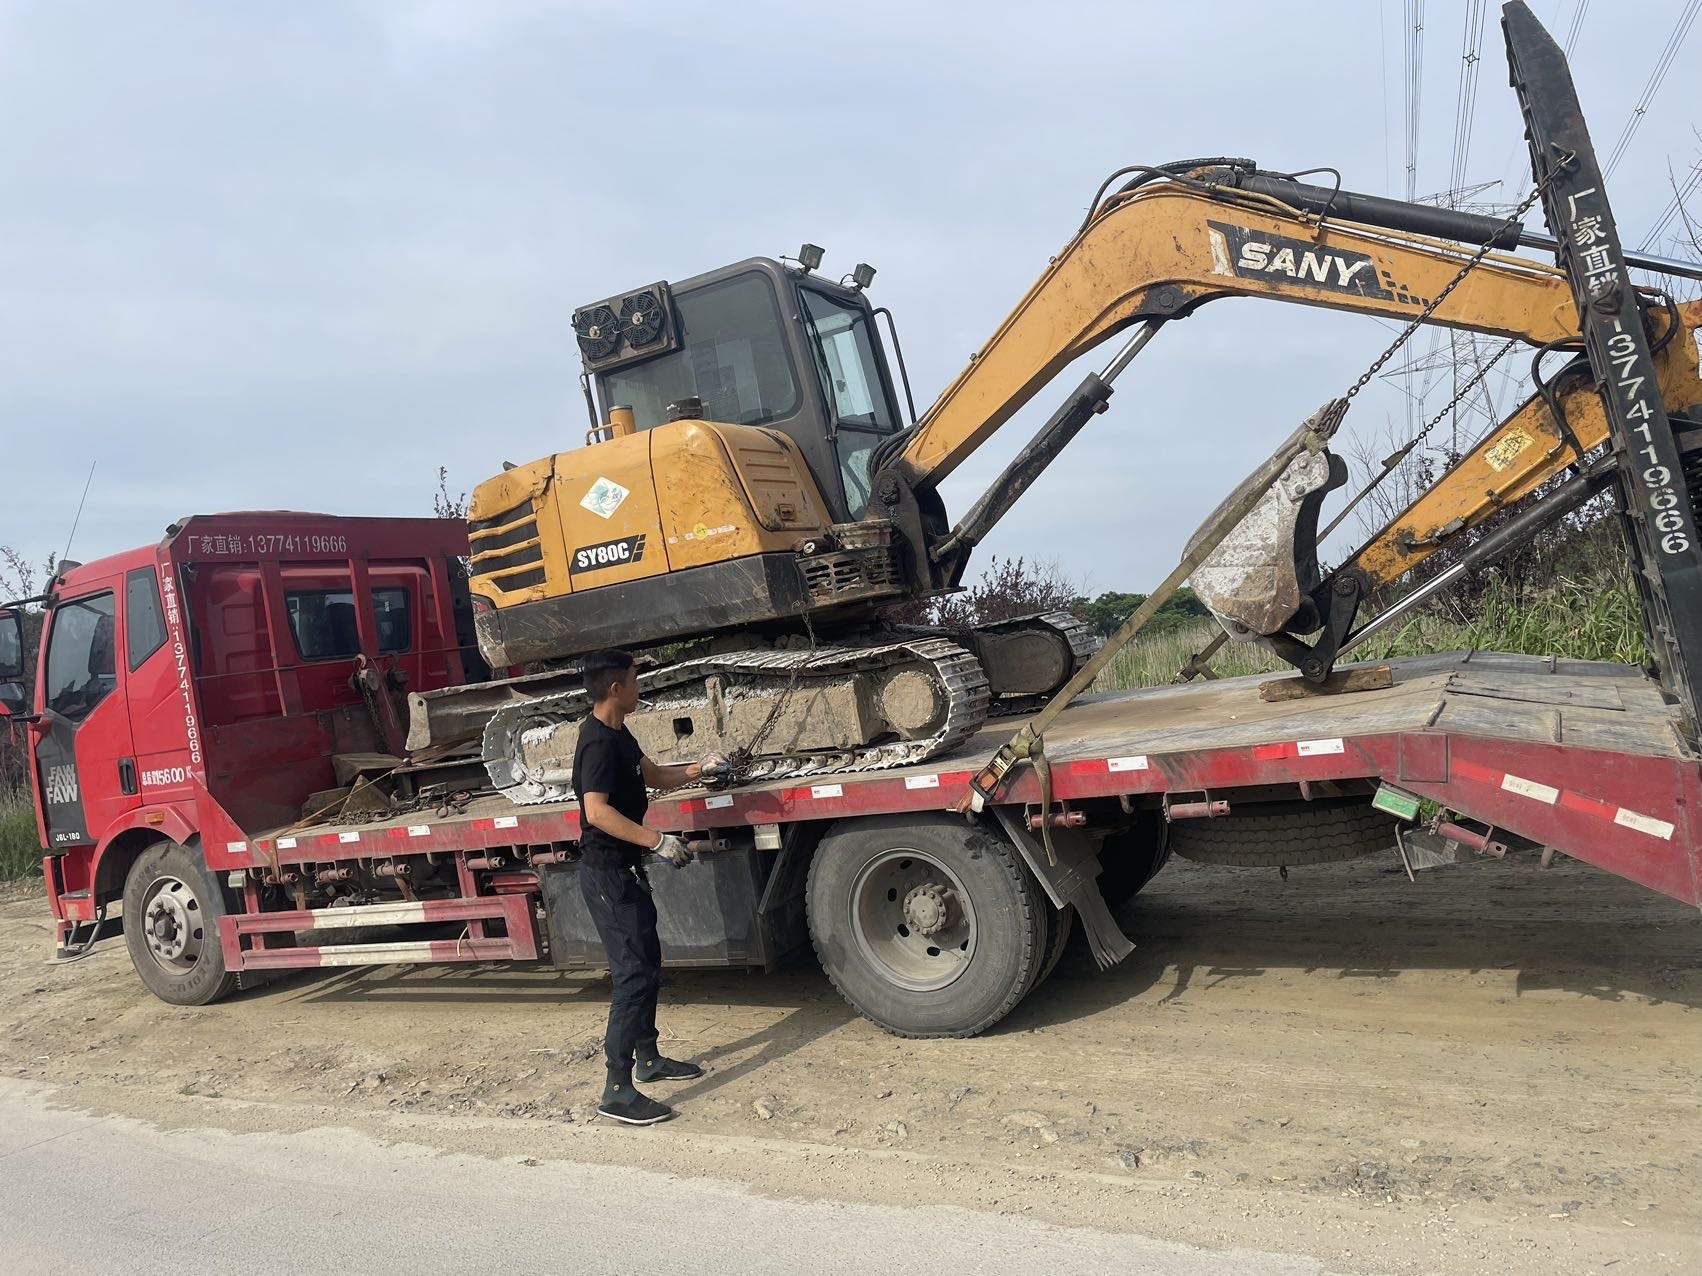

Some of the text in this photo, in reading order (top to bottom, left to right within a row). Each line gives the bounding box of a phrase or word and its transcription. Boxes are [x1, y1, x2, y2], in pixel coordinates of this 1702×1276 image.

[1238, 241, 1371, 287] SANY
[577, 541, 630, 568] SY80C
[50, 764, 75, 779] FAW
[48, 773, 76, 791] FAW
[46, 784, 78, 804] FAW
